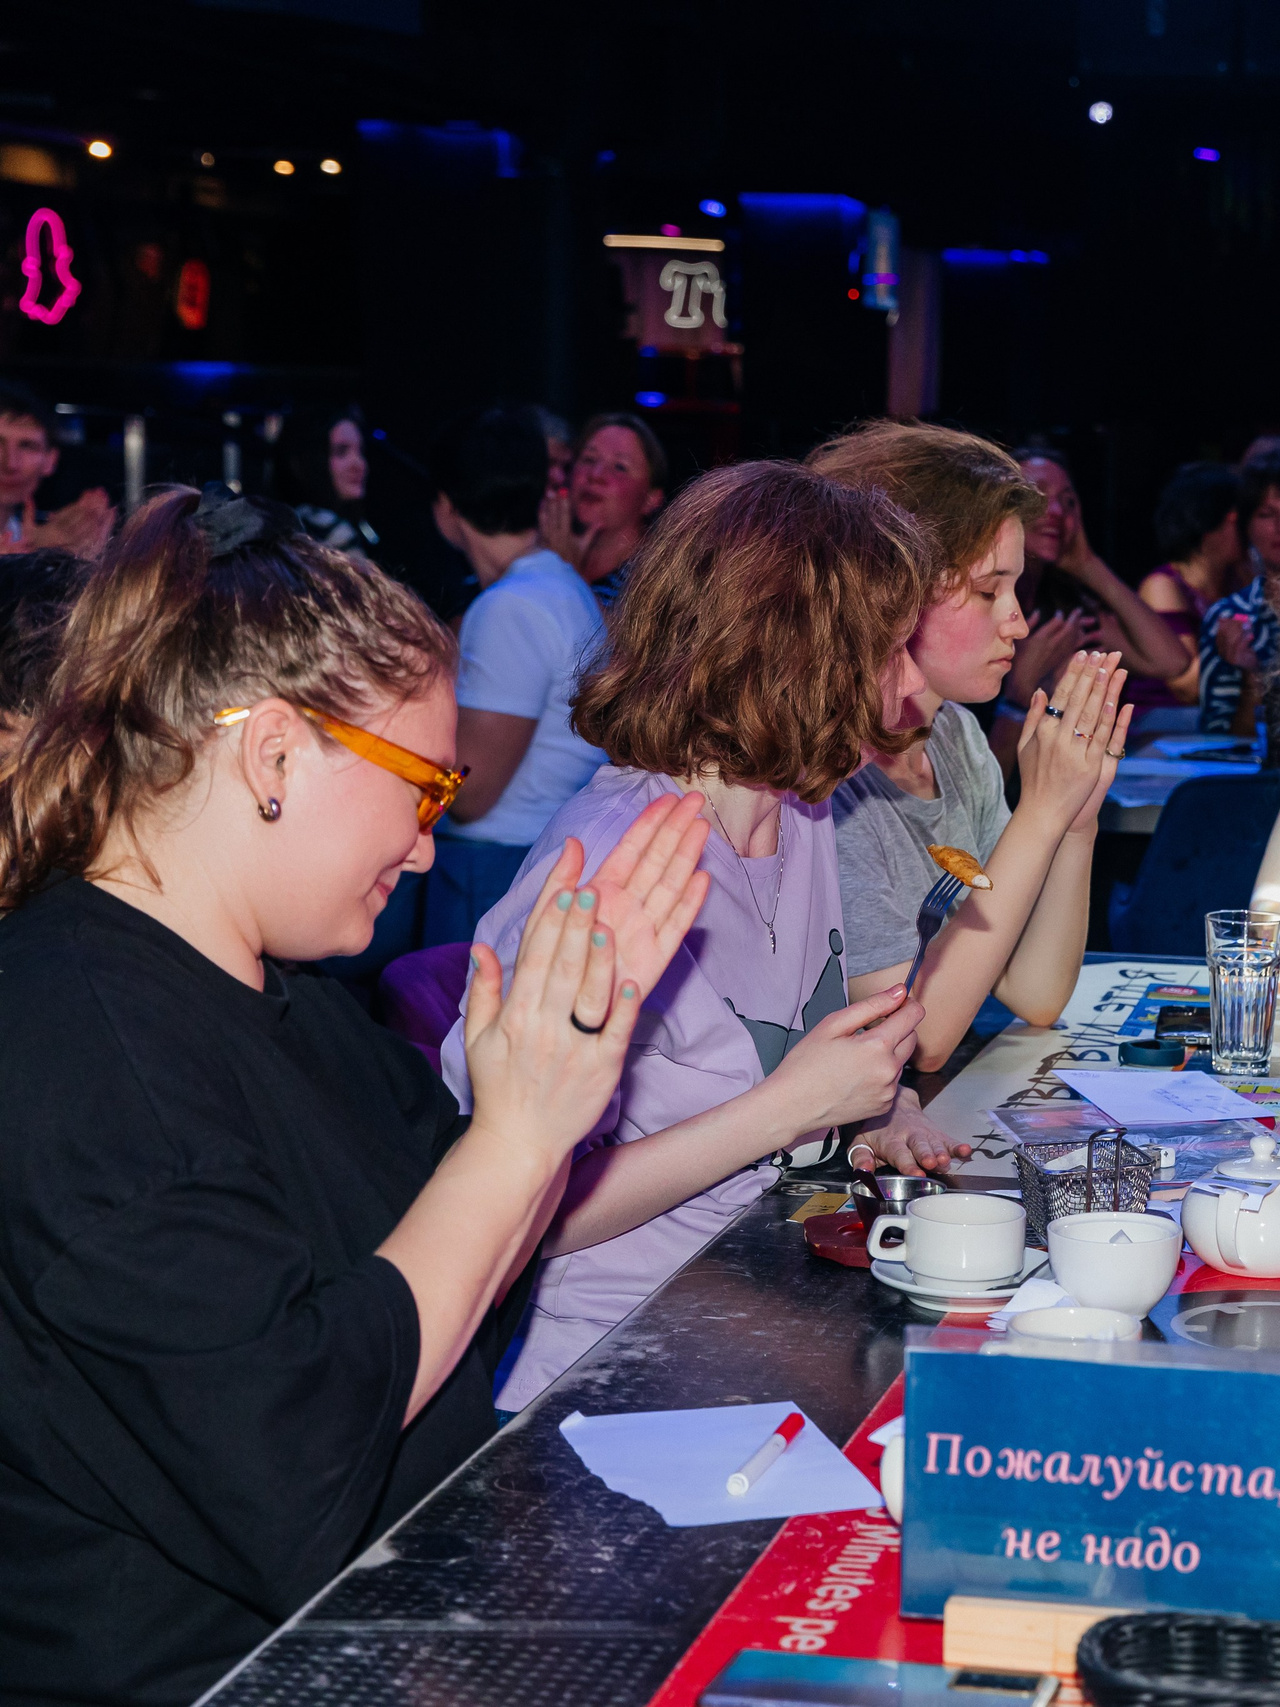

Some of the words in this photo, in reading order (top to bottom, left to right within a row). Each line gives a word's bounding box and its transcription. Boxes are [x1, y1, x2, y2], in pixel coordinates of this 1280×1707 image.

[806, 1519, 901, 1612] Minutes
[1002, 1526, 1062, 1563] не
[1082, 1526, 1201, 1574] надо
[775, 1615, 839, 1650] pe
